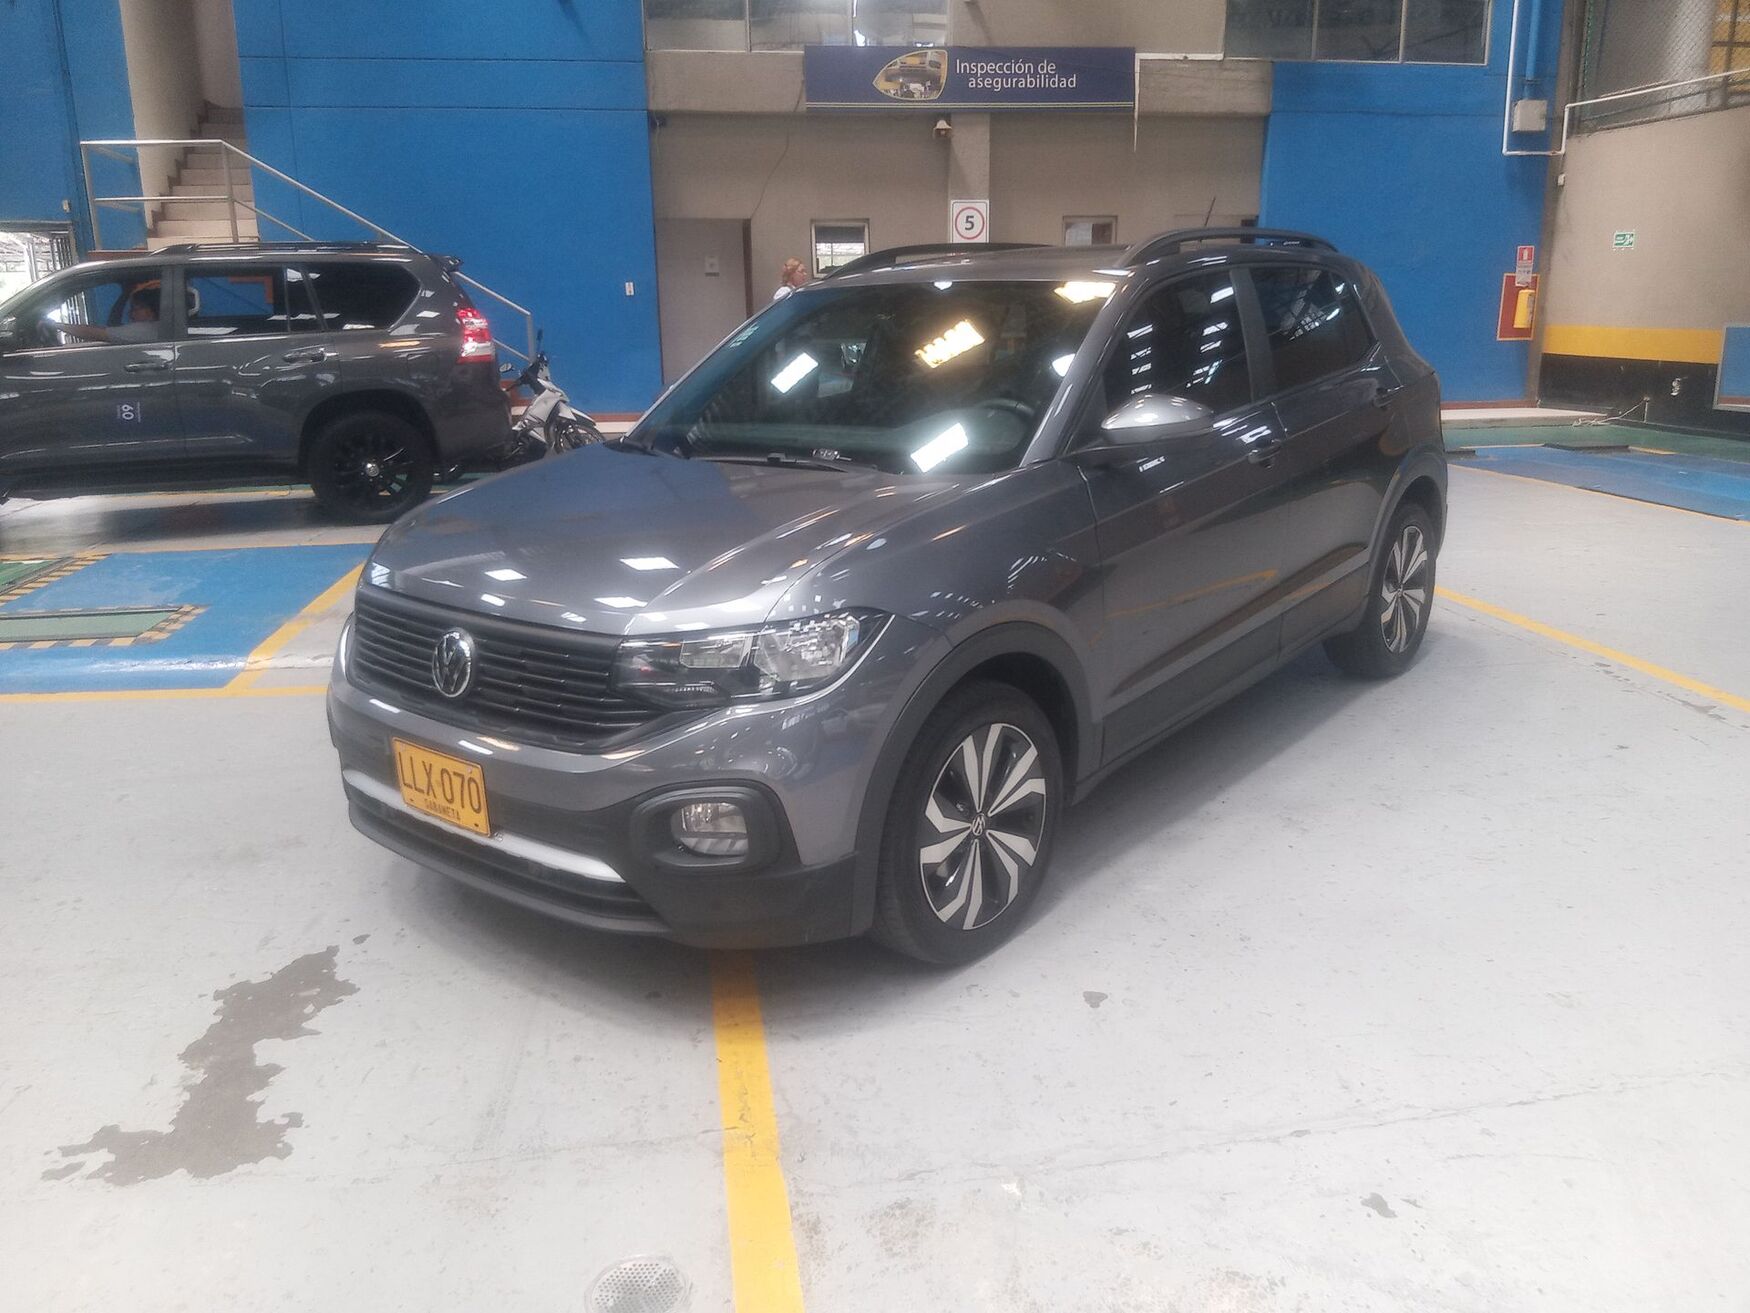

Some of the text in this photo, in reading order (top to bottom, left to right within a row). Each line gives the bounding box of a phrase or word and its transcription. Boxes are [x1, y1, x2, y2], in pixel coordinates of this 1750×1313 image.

[956, 58, 1057, 77] Inspección de
[968, 74, 1077, 92] asegurabilidad
[964, 215, 975, 231] 5
